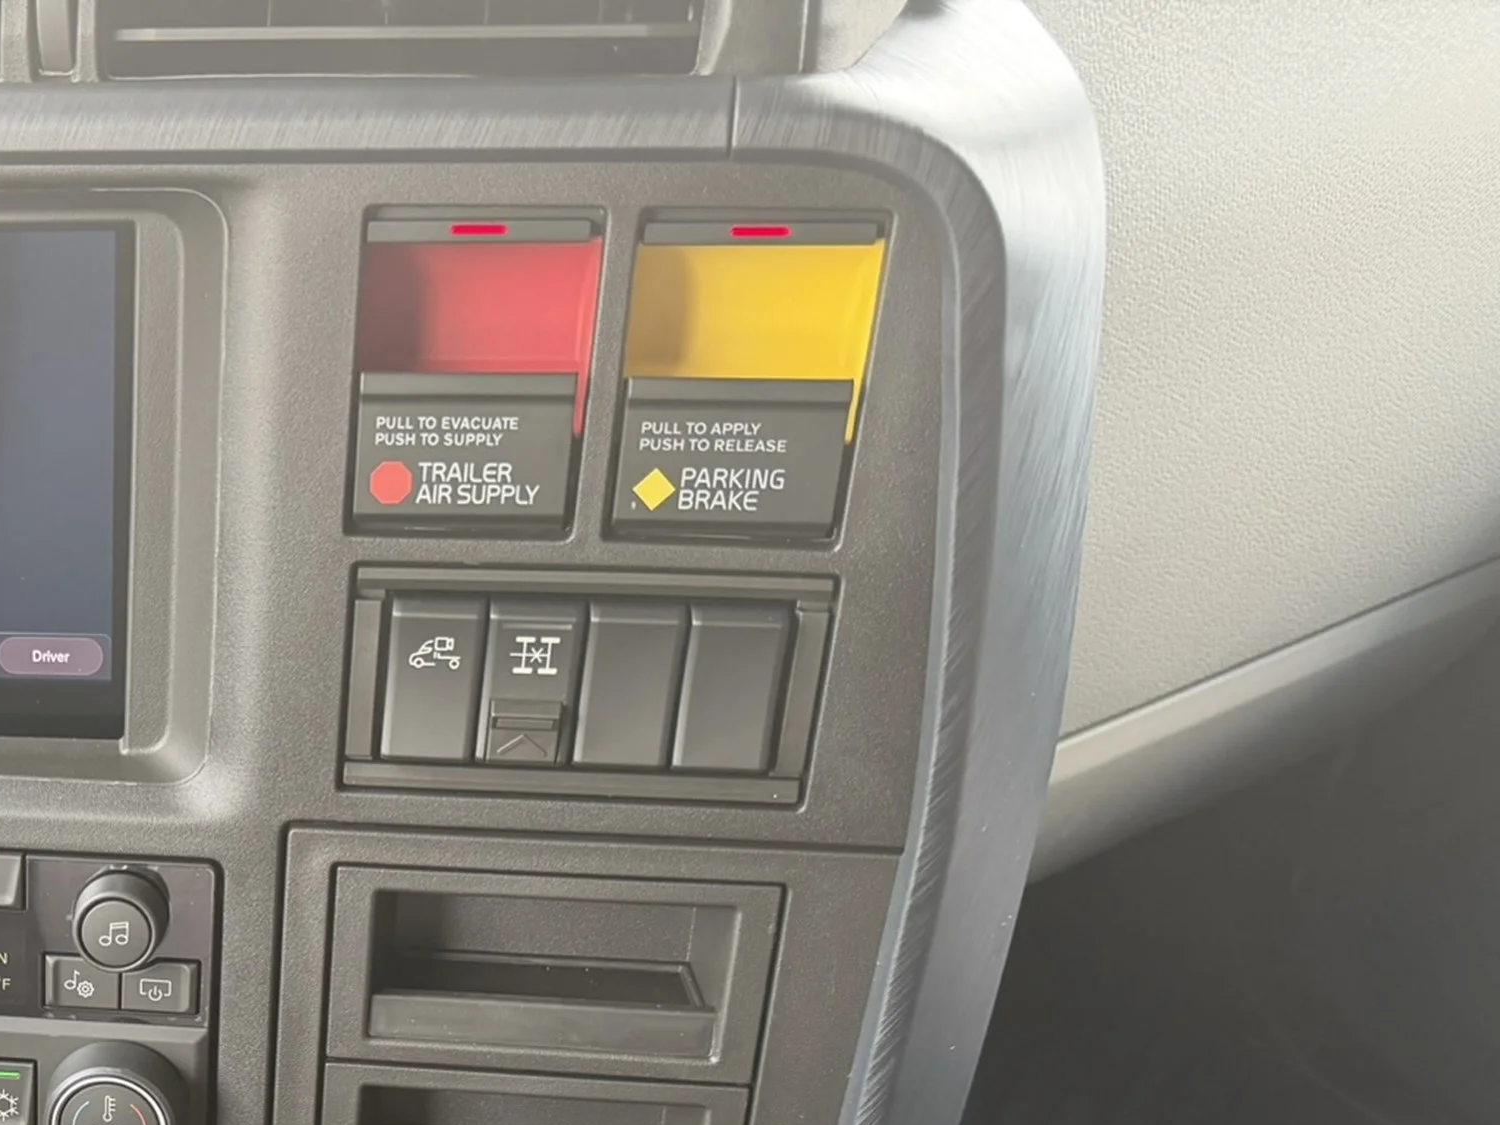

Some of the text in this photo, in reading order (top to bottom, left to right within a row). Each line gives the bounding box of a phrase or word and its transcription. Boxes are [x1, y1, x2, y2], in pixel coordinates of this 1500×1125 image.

[375, 415, 519, 430] PULL TO EVACUATE
[641, 421, 762, 436] PULL TO APPLY
[374, 432, 503, 447] PUSH TO SUPPLY
[639, 437, 787, 453] PUSH TO RELEASE
[418, 461, 513, 483] TRAILER
[679, 467, 786, 492] PARKING
[415, 483, 540, 505] AIR SUPPLY
[677, 489, 760, 511] BRAKE
[32, 649, 70, 663] Driver
